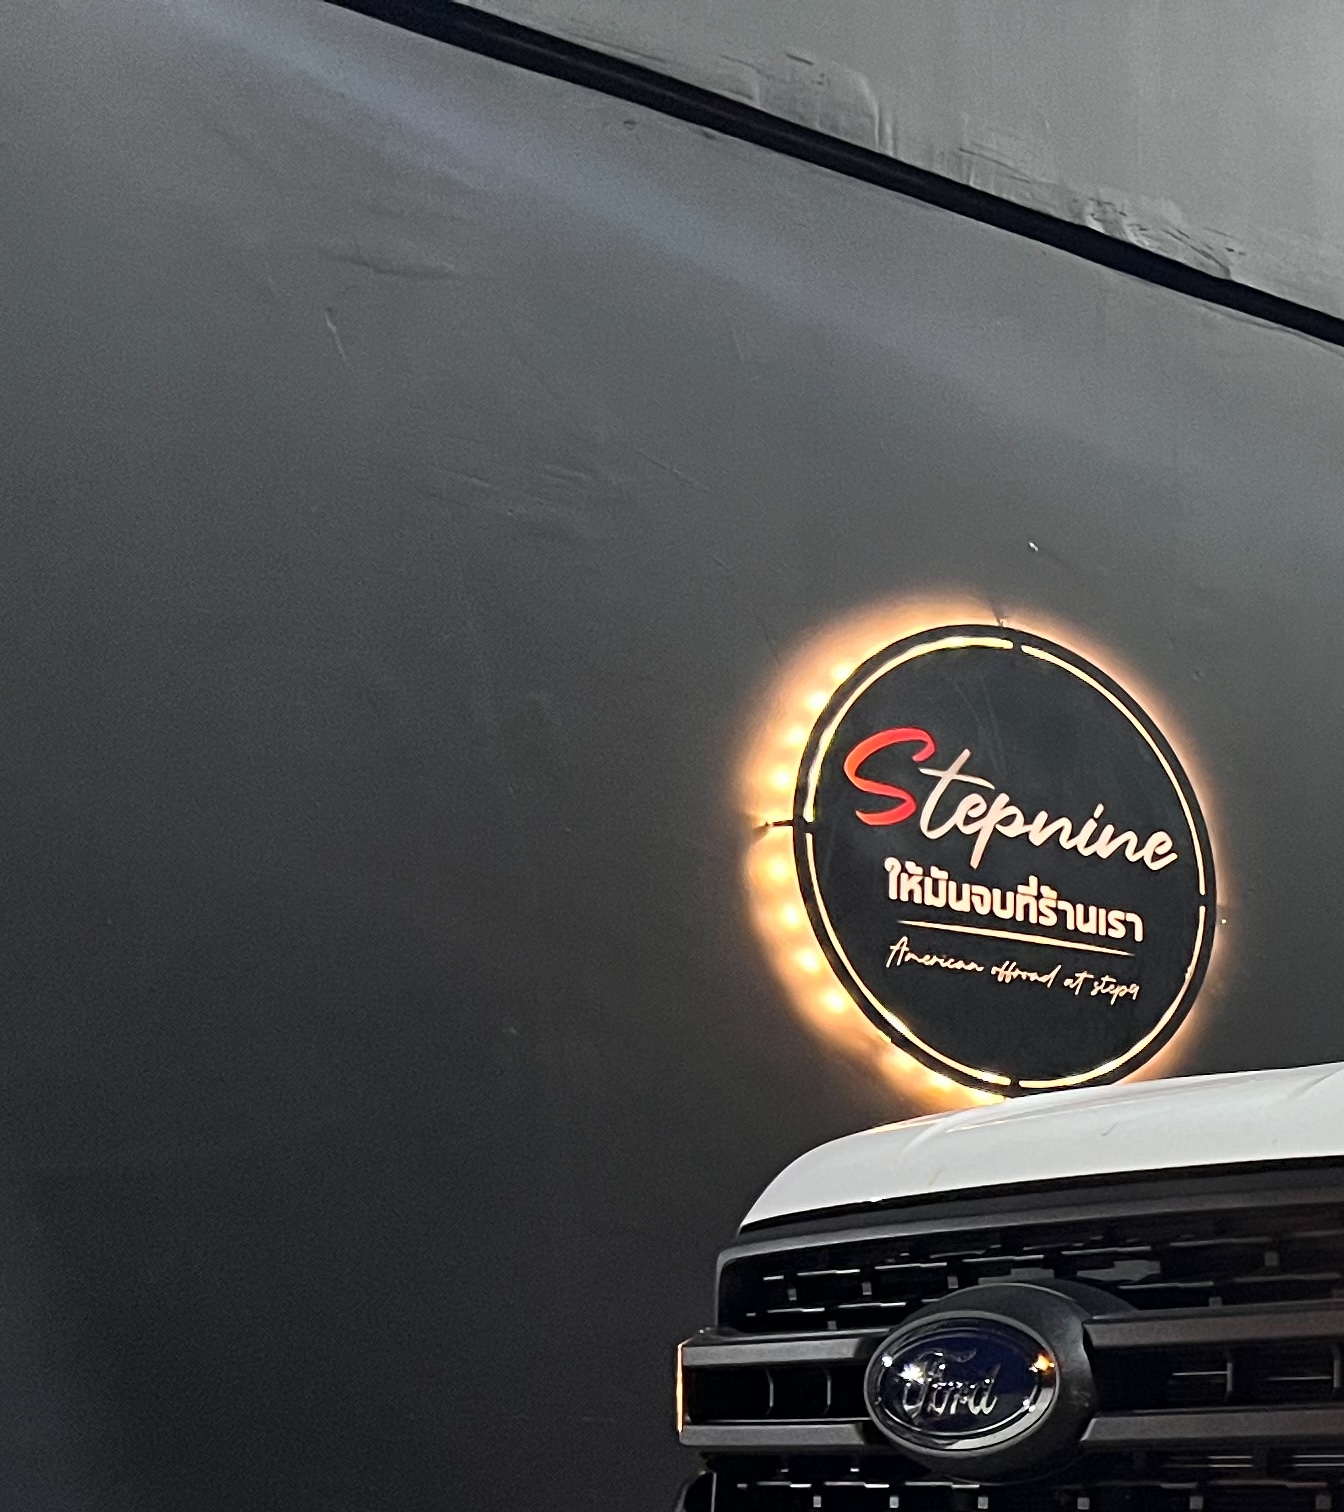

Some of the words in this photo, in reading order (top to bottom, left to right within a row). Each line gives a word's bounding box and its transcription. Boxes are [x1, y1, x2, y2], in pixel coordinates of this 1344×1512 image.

[844, 728, 1178, 870] Stepnine
[884, 856, 1145, 942] ให้มันจบที่ร้านเรา
[885, 935, 985, 971] American
[990, 959, 1062, 988] offroad
[1063, 970, 1095, 996] at
[1090, 974, 1140, 1006] step9
[899, 1347, 1002, 1420] Ford
